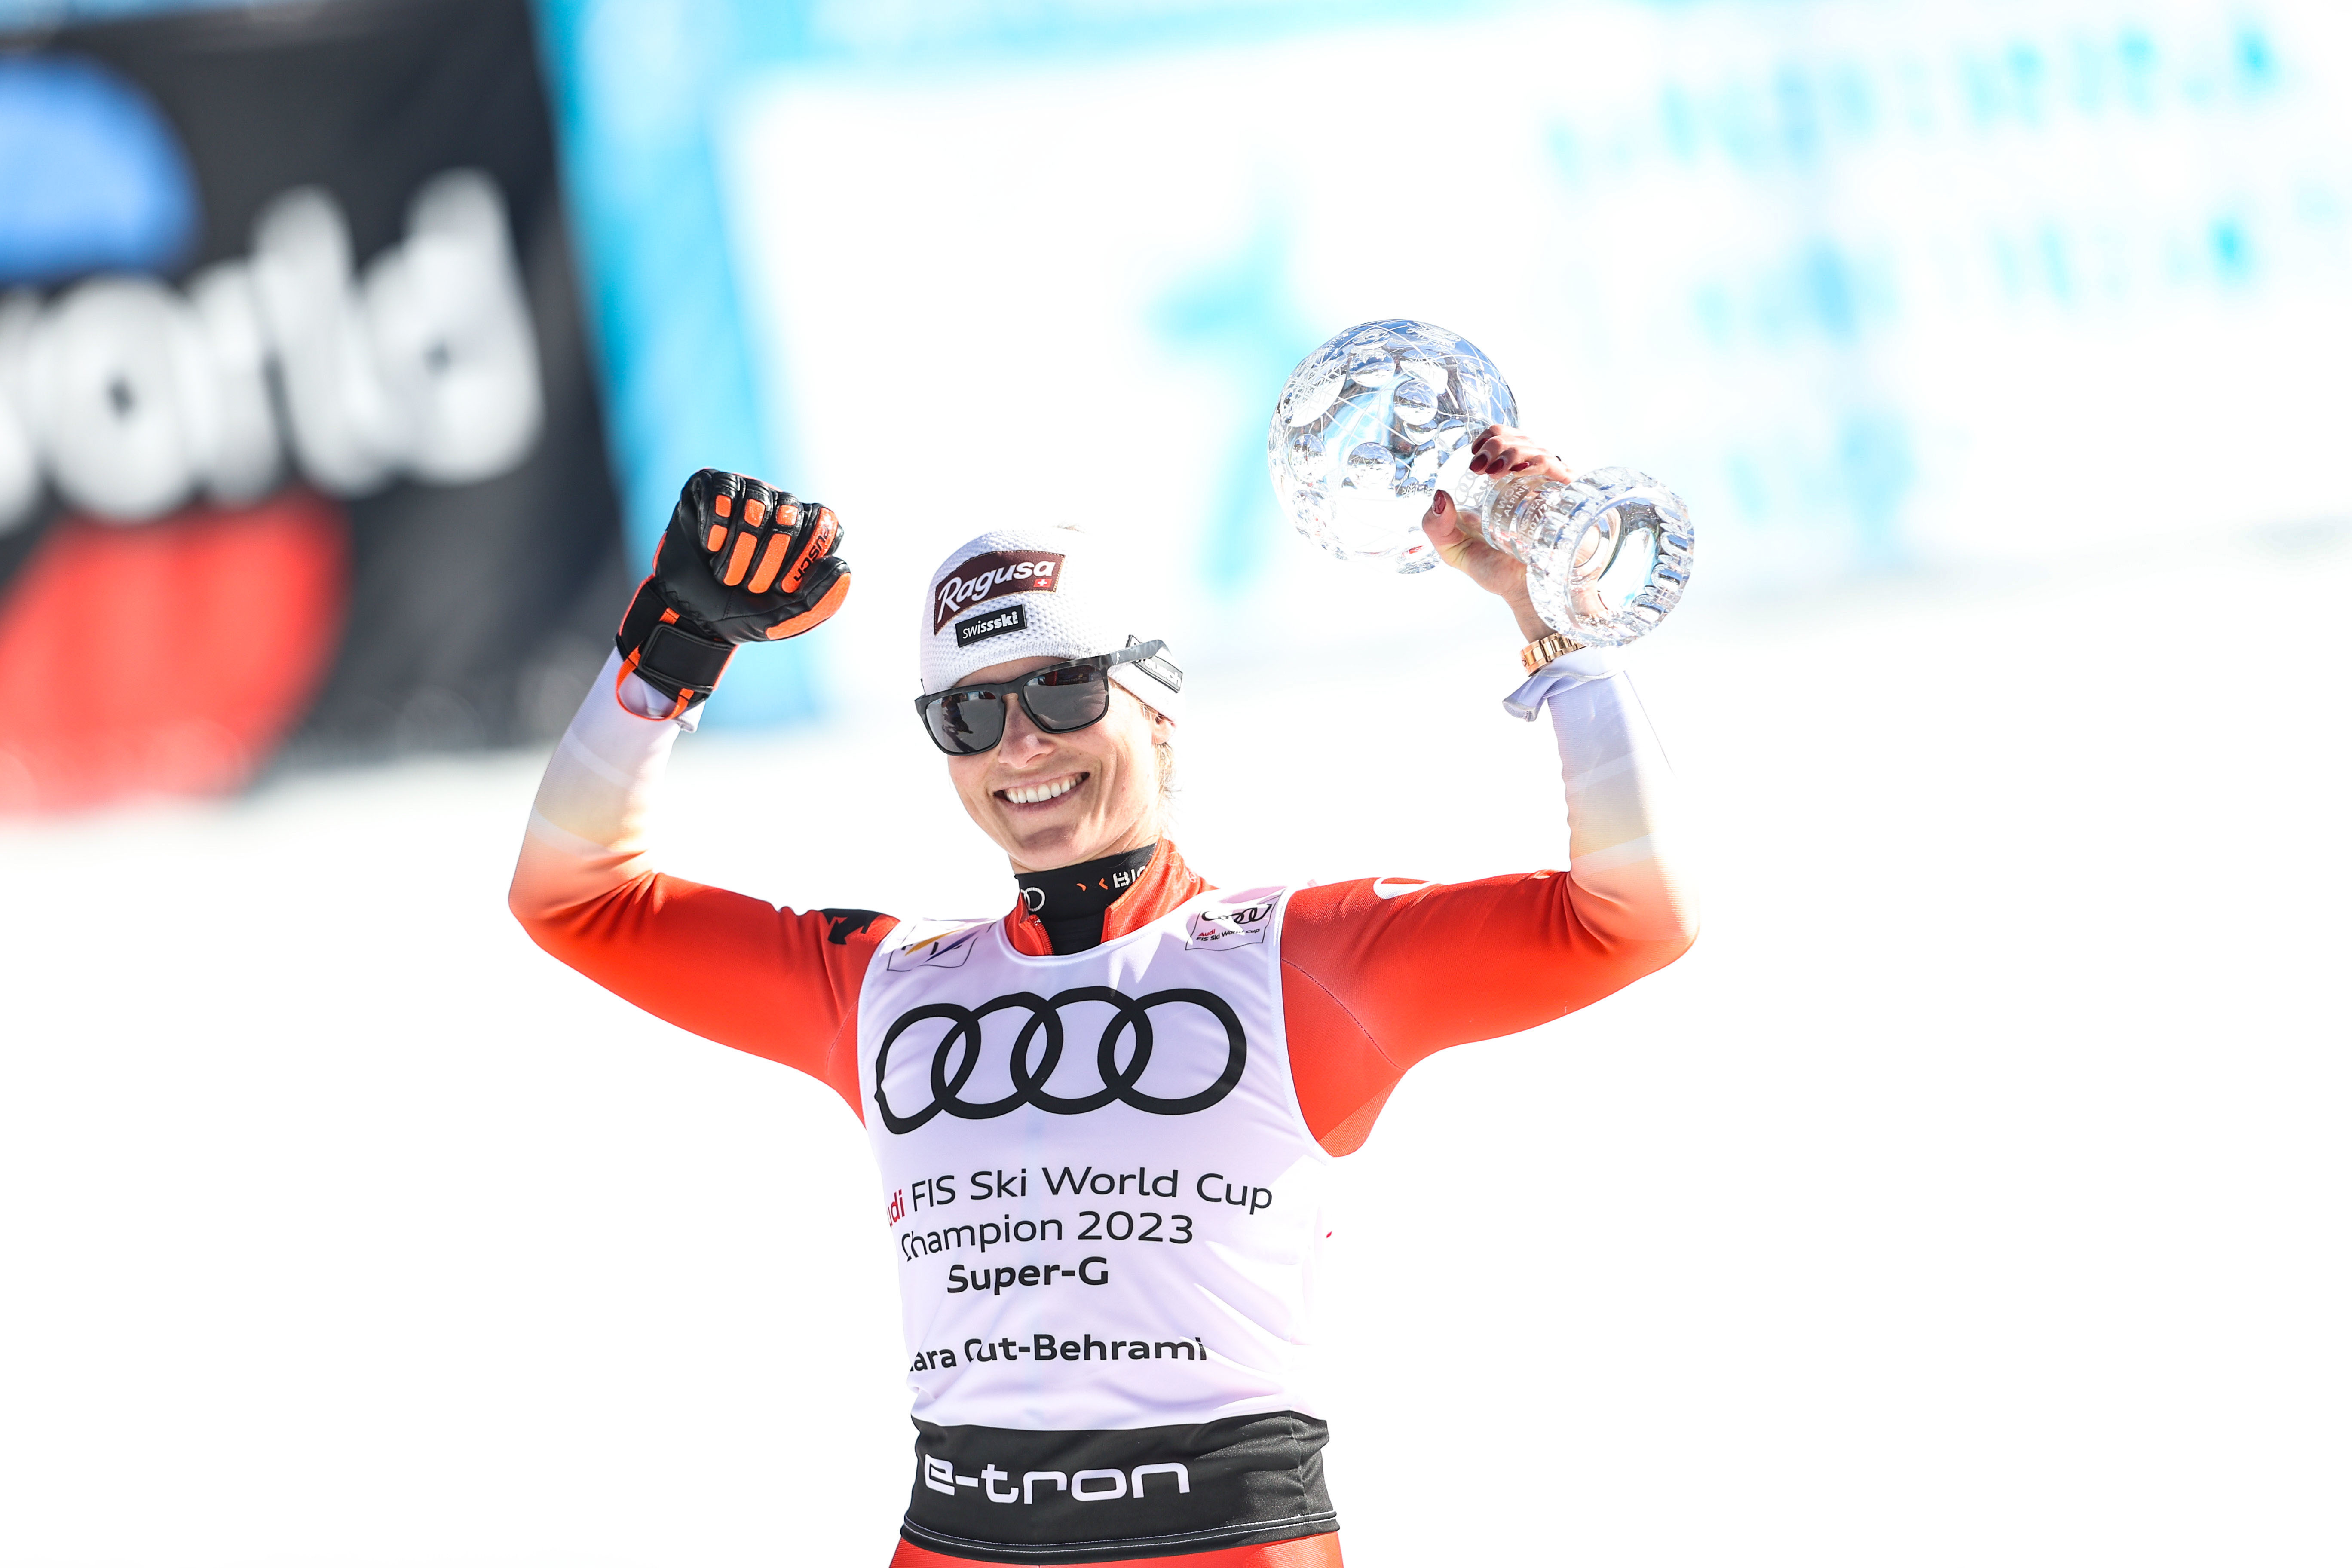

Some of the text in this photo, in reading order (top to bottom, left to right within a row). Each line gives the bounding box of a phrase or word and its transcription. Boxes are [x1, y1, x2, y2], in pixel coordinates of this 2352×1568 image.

[0, 168, 544, 533] orld
[1504, 484, 1530, 517] ALPINE
[794, 525, 830, 581] eusch
[937, 560, 1055, 624] Ragusa
[963, 611, 1018, 639] swissski
[1140, 658, 1181, 688] eusch
[886, 1167, 1272, 1228] udi FIS Ski World Cup
[902, 1211, 1193, 1262] Champion 2023
[947, 1256, 1108, 1295] Super-G
[910, 1349, 957, 1371] ara
[925, 1454, 1190, 1504] e-tron
